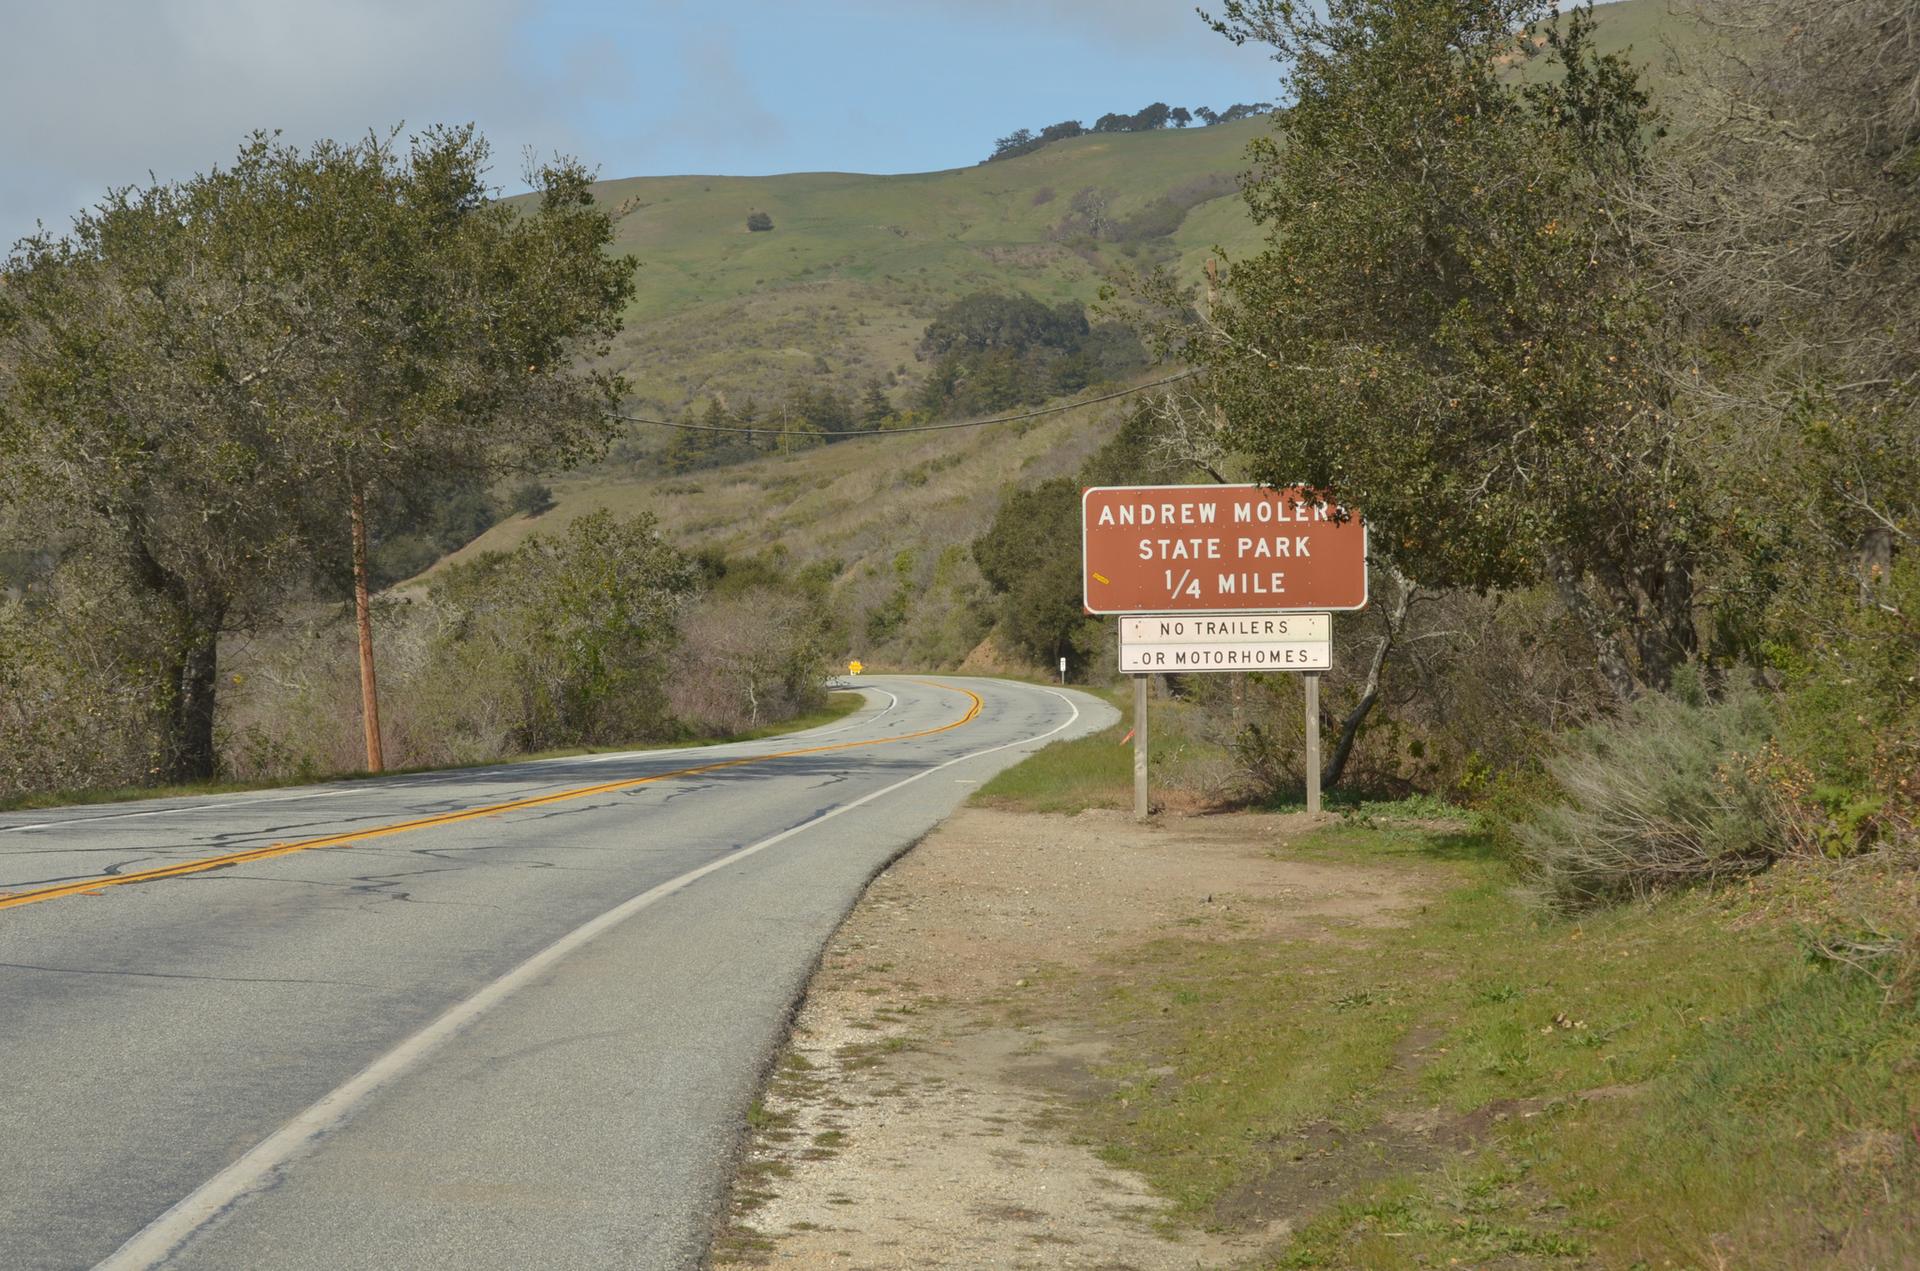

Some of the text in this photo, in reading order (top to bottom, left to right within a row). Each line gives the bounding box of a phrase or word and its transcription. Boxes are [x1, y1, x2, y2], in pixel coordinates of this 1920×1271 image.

[1098, 502, 1217, 526] ANDREW
[1138, 536, 1311, 560] STATE PARK
[1165, 568, 1286, 600] 1/4 MILE
[1160, 620, 1289, 636] NO TRAILERS
[1175, 649, 1309, 665] MOTORHOMES
